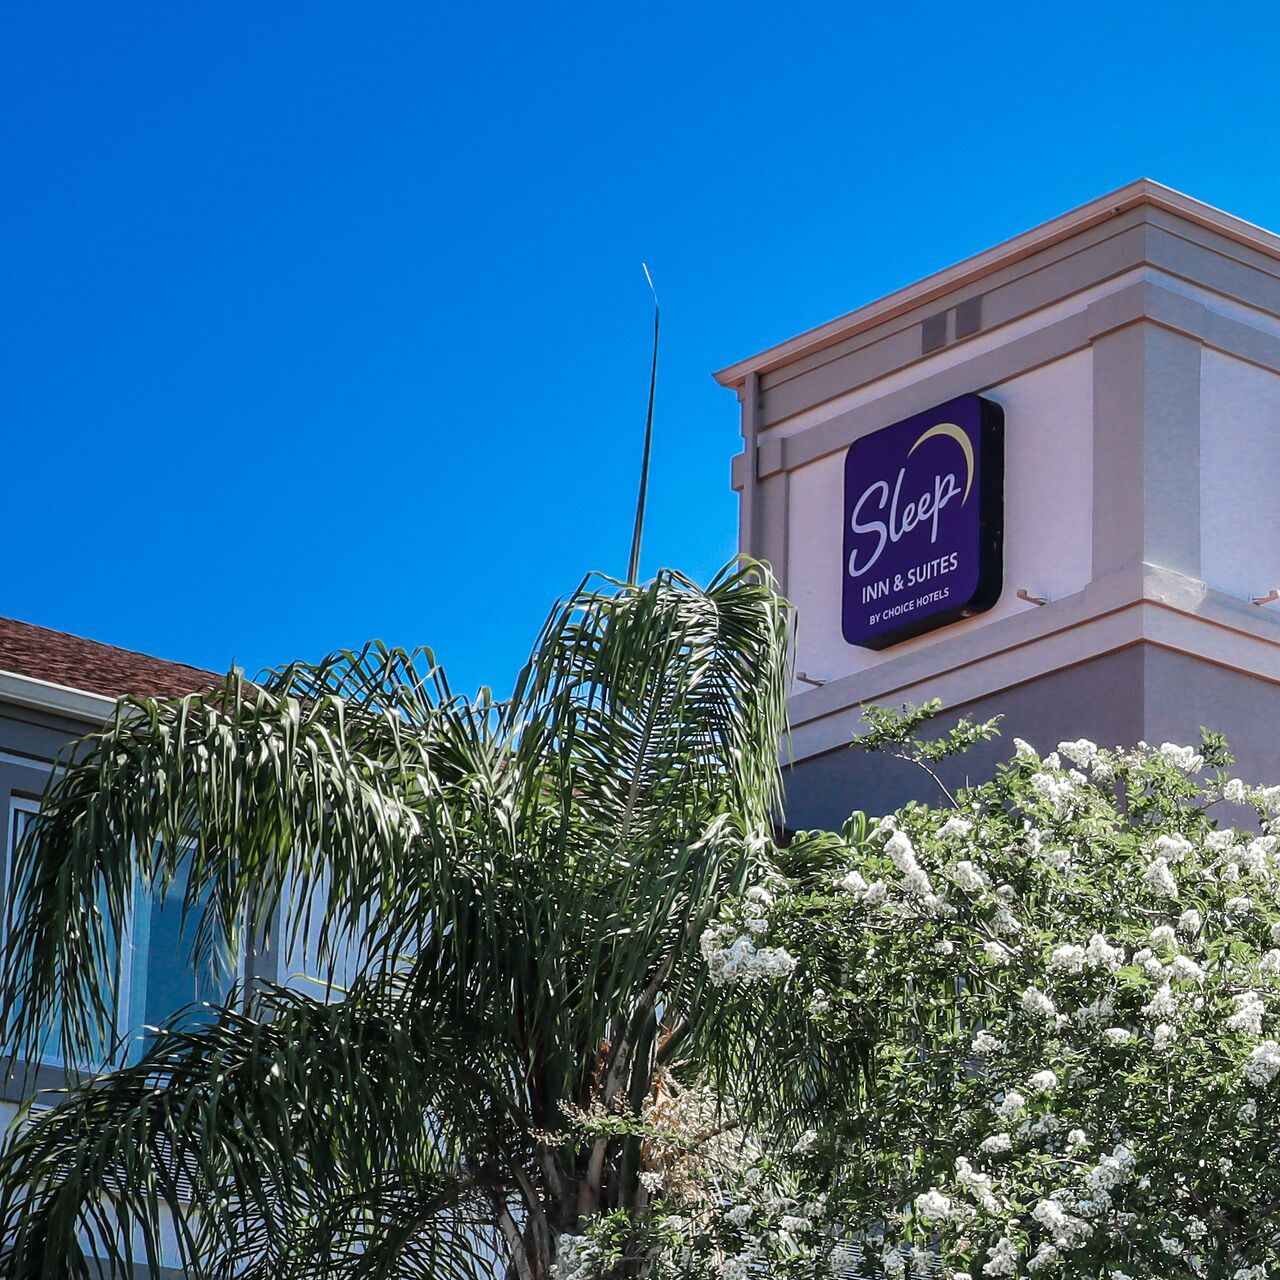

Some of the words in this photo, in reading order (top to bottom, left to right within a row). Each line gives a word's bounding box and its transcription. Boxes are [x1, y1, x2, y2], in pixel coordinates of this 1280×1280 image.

[848, 467, 962, 578] Sleep
[861, 578, 890, 604] INN
[893, 573, 905, 592] &
[907, 552, 958, 587] SUITES
[869, 613, 880, 625] BY
[882, 600, 915, 621] CHOICE
[916, 587, 950, 608] HOTELS
